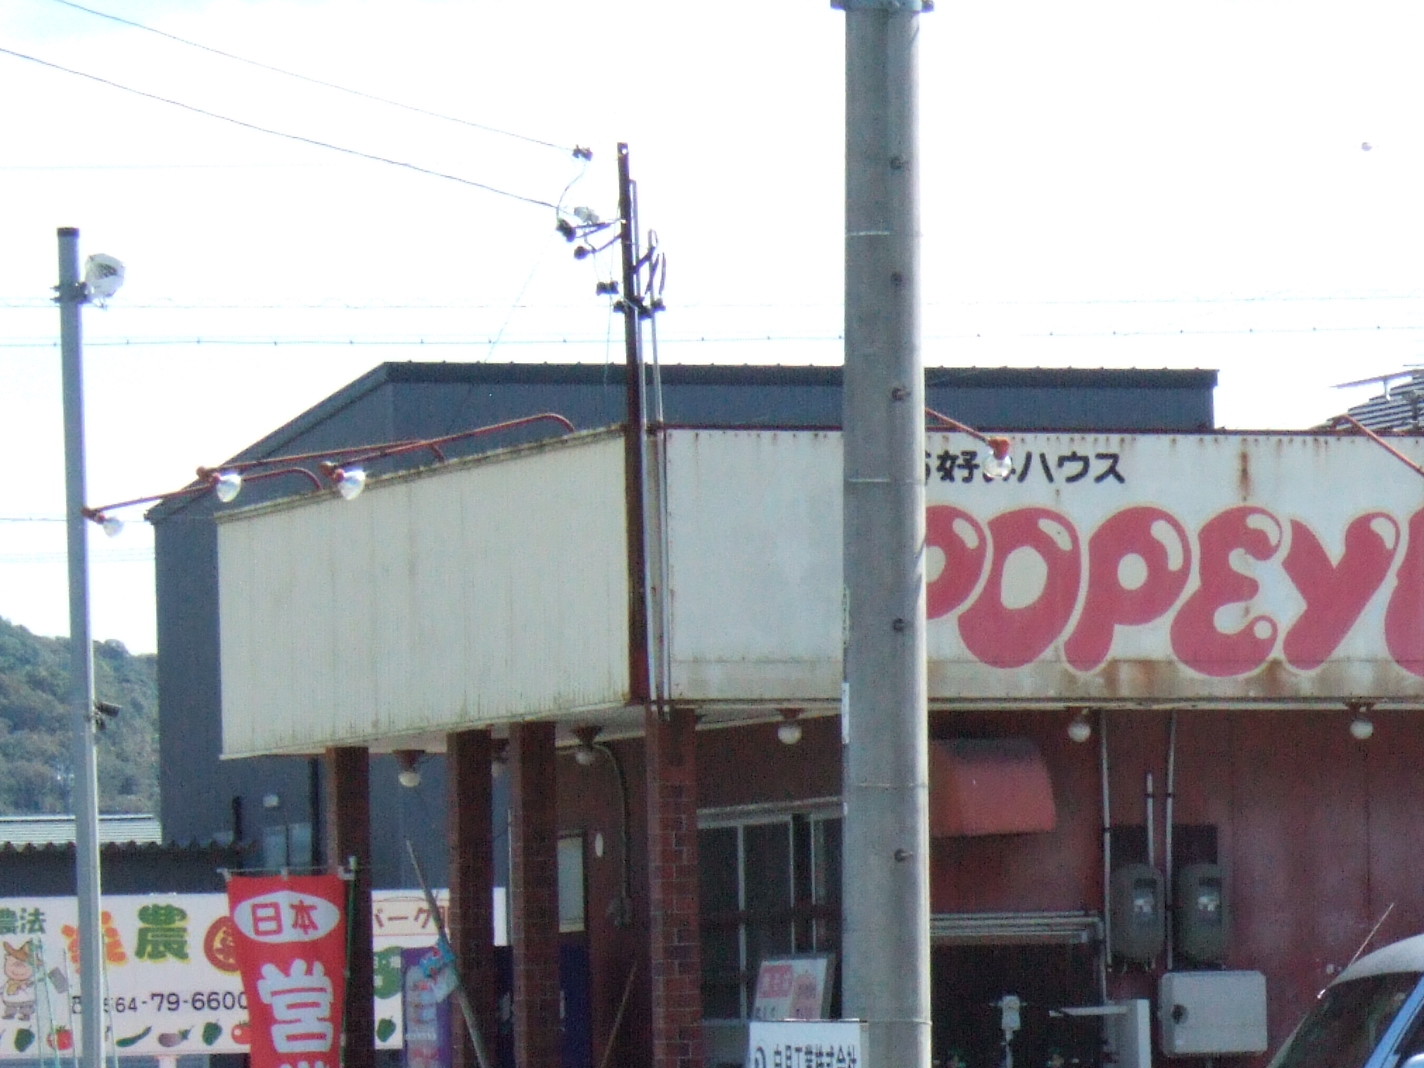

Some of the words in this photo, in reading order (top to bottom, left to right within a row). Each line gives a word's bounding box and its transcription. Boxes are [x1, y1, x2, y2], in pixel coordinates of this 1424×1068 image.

[926, 450, 1126, 485] 好ハウス
[251, 899, 320, 937] 日本
